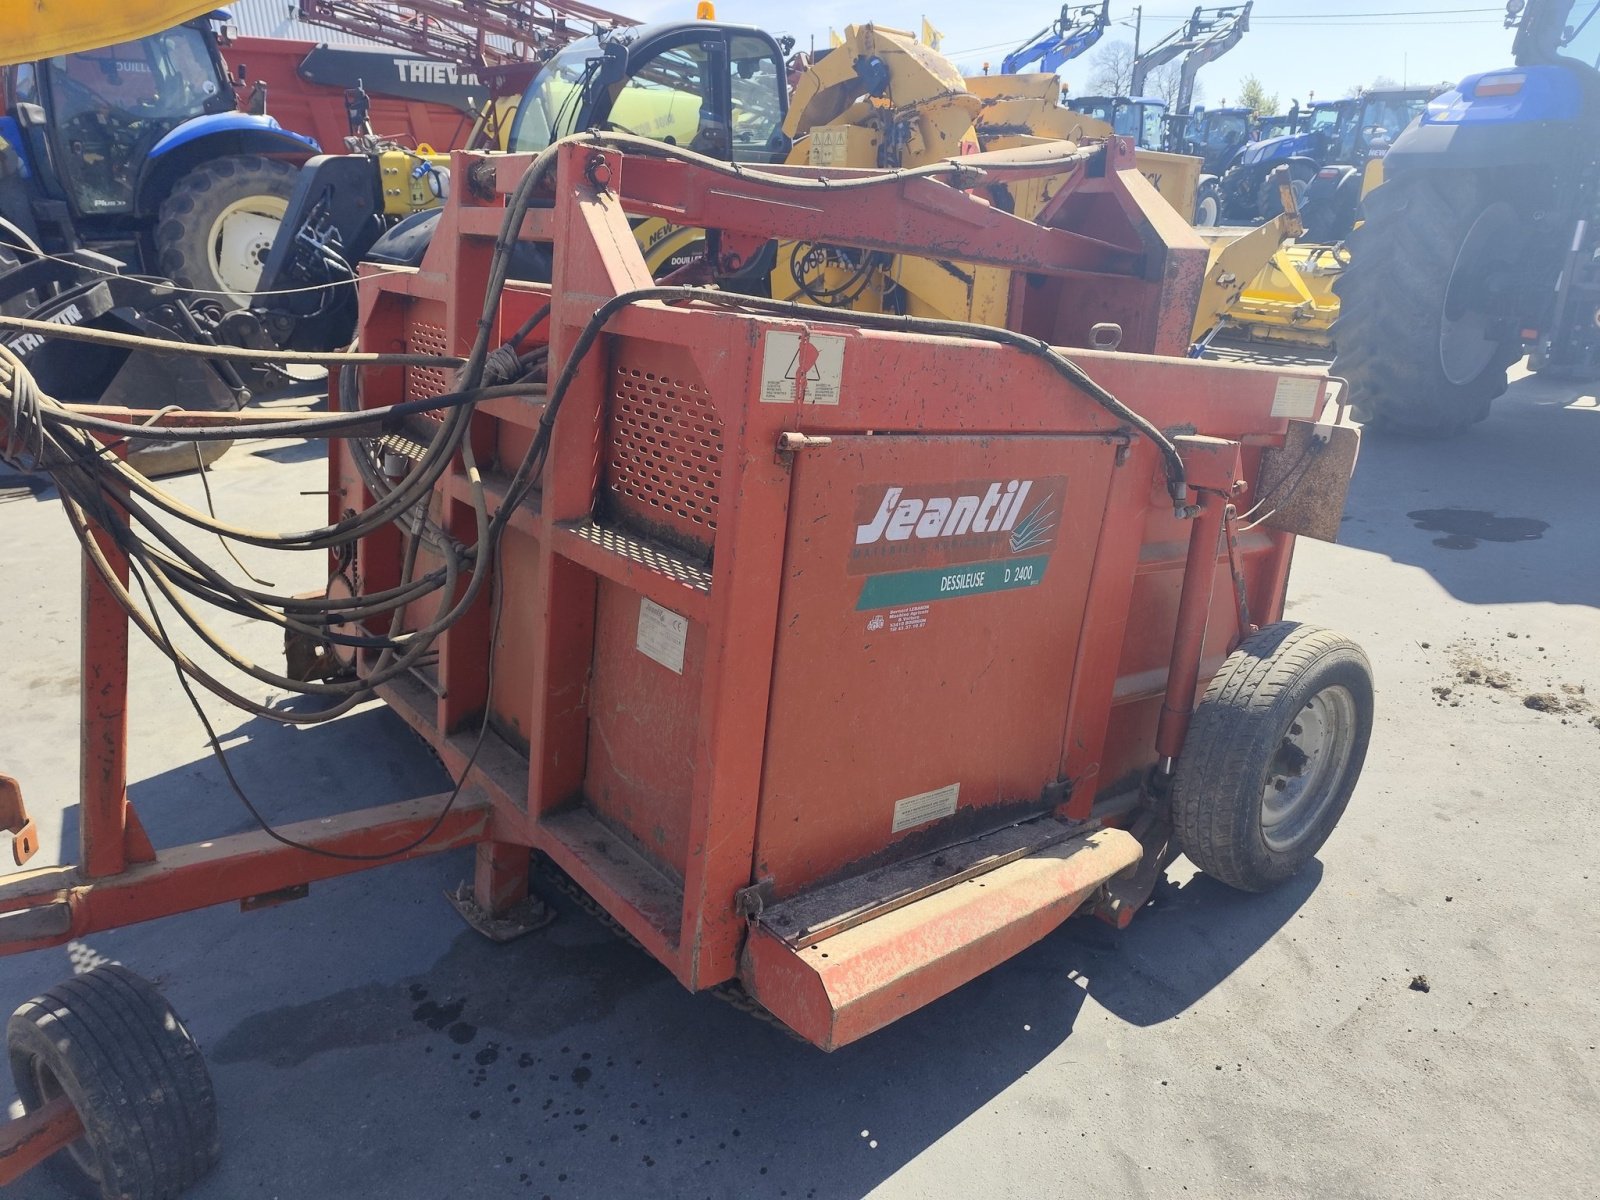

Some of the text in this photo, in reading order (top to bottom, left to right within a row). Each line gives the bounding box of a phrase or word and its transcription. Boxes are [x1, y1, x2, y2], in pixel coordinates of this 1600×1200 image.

[856, 479, 1034, 545] Jeantil
[940, 565, 1033, 592] DESSILEUSE D 2400
